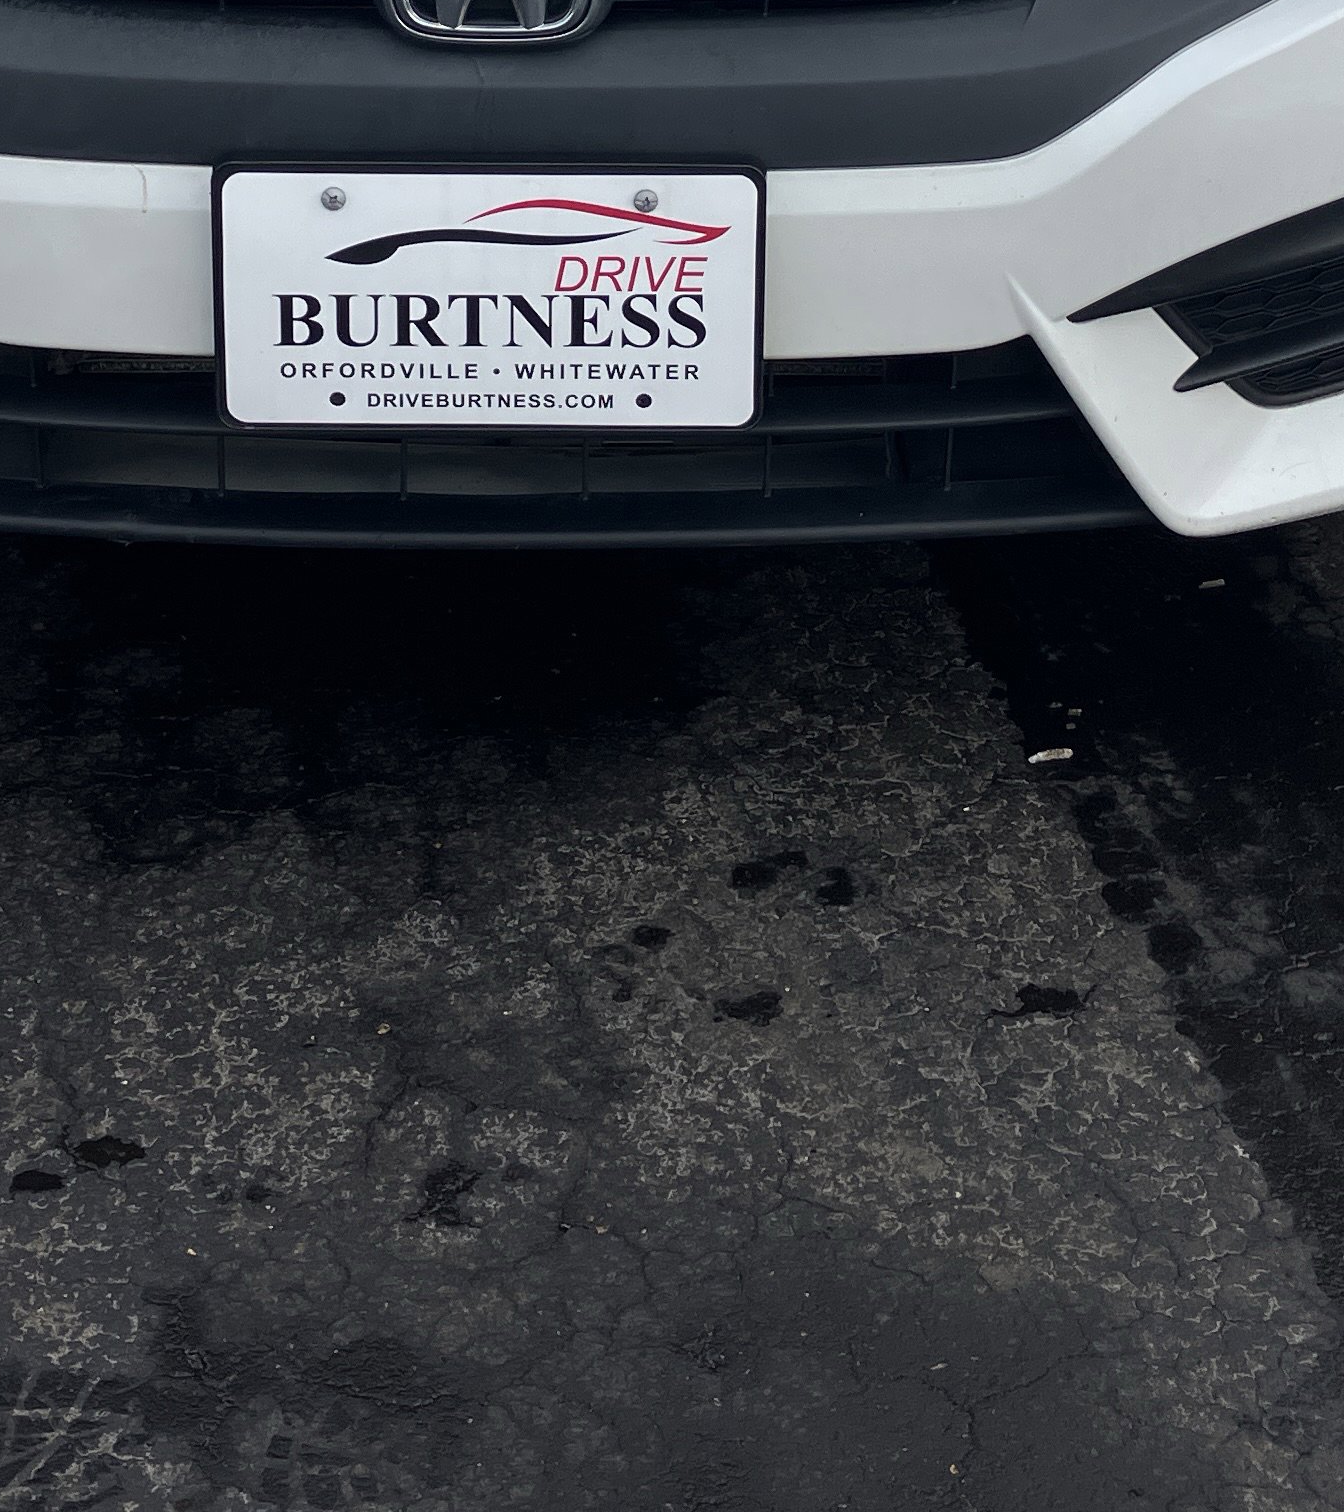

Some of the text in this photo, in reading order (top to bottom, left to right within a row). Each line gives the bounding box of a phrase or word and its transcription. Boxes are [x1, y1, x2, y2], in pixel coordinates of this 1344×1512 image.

[554, 256, 708, 292] DRIVE
[272, 293, 707, 349] BURTNESS
[280, 362, 700, 380] ORFORDVILLE WHITEWATER
[367, 393, 614, 409] DRIVEBURTNESS.COM
